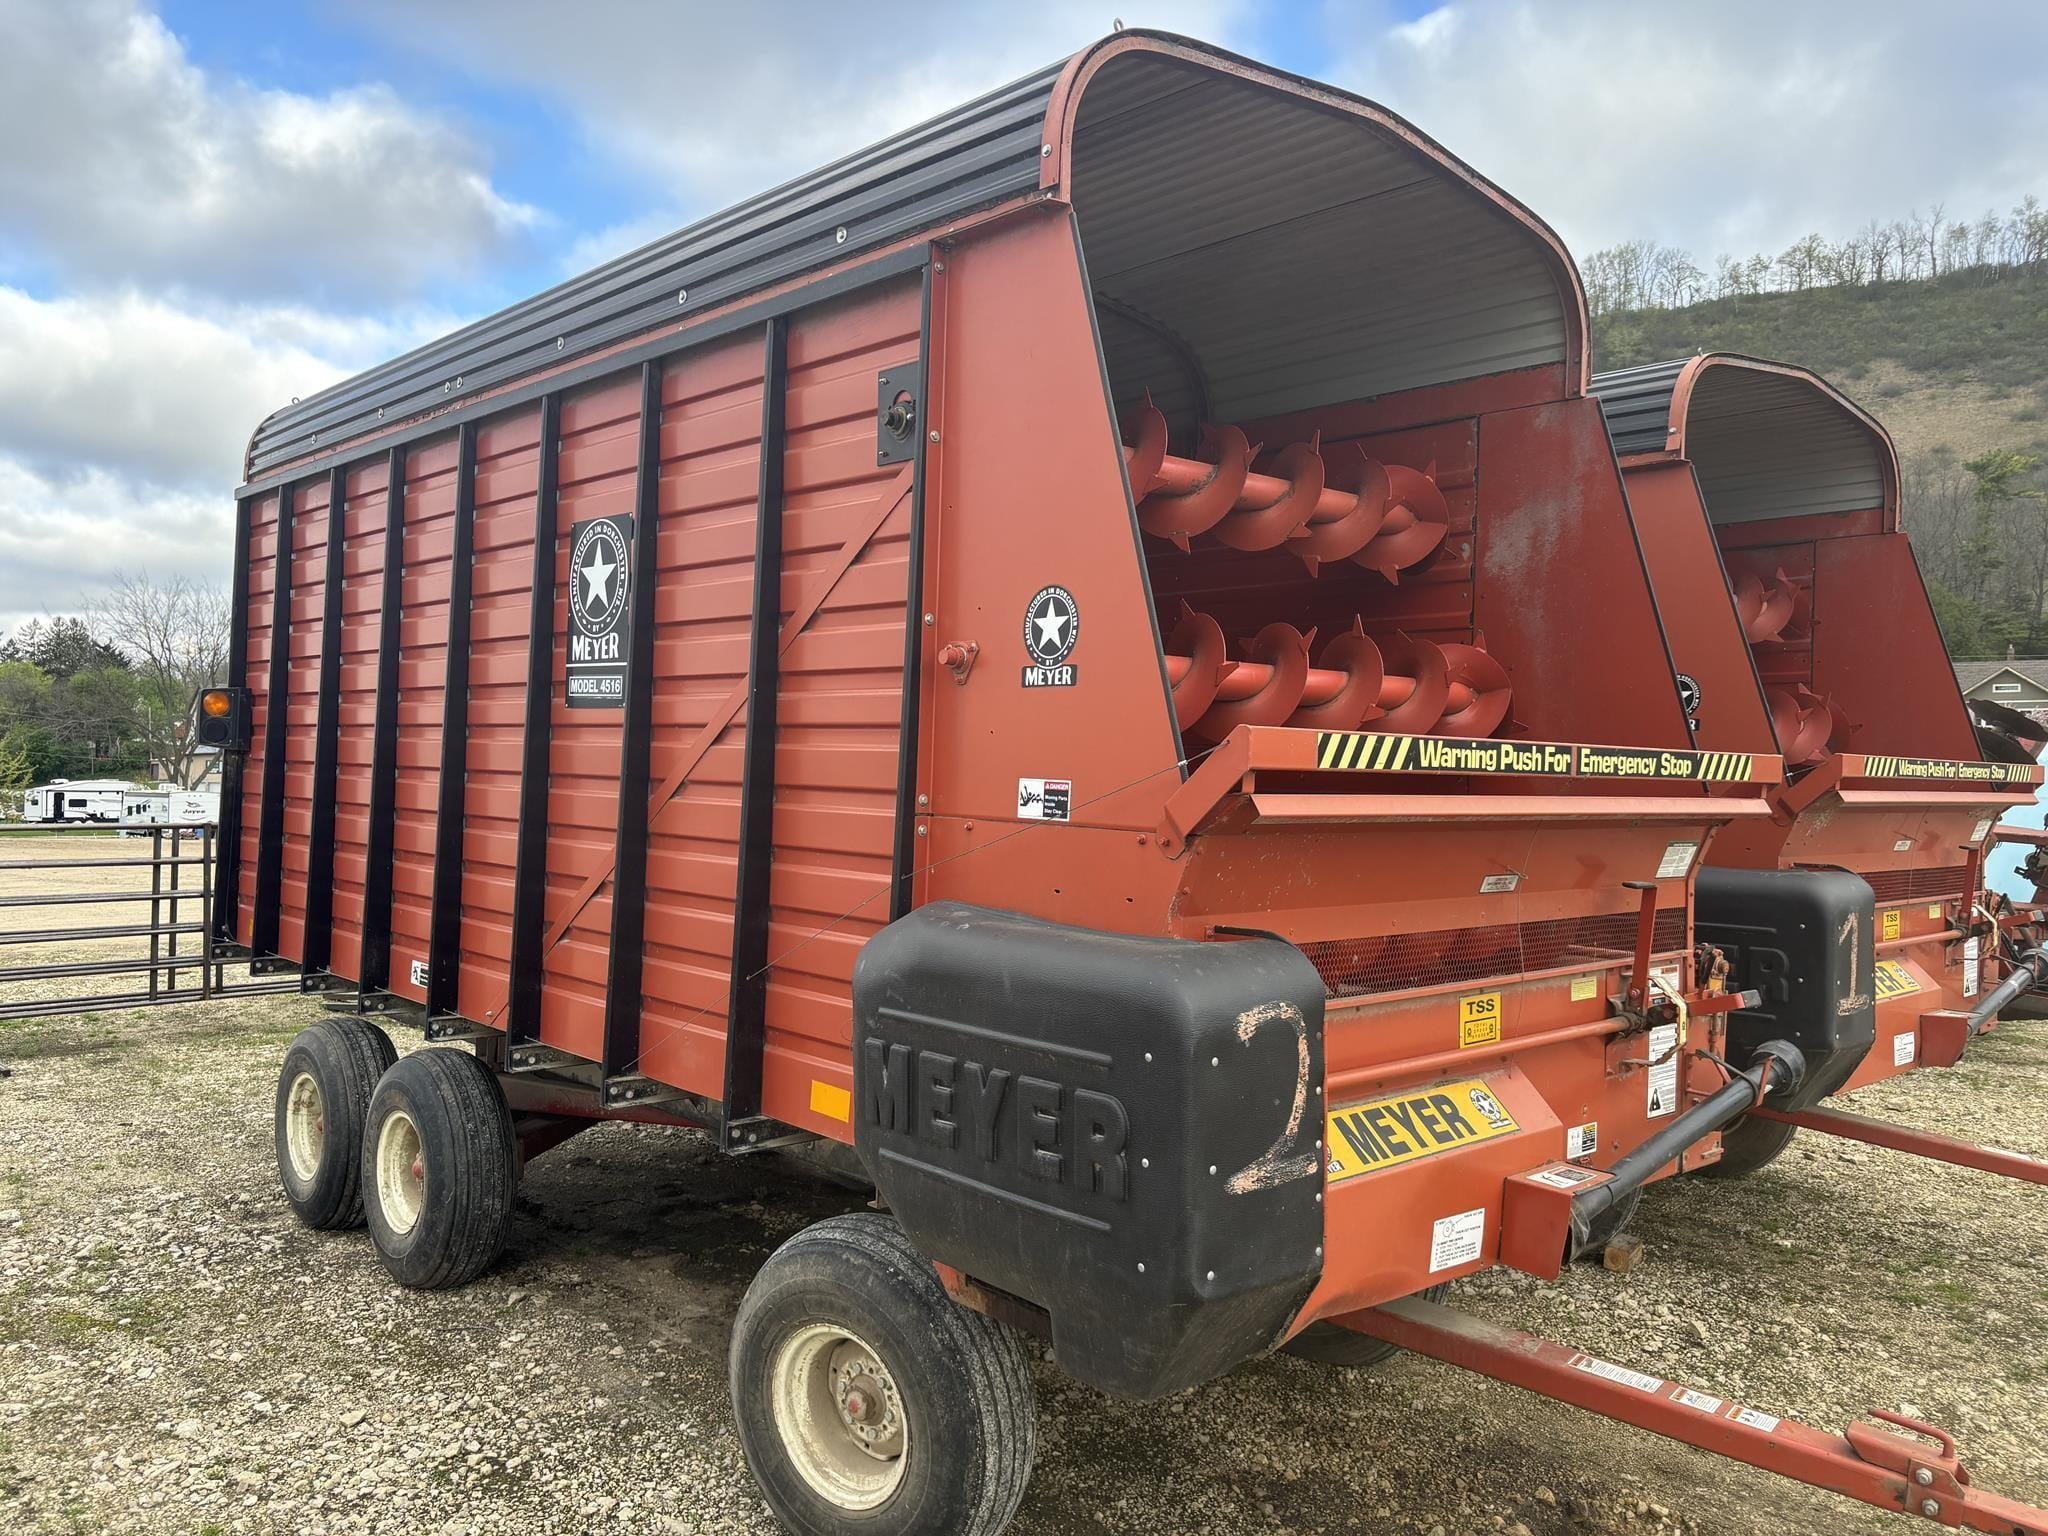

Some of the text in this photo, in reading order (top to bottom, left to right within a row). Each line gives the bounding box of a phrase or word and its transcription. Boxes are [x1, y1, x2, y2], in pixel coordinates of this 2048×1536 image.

[572, 529, 594, 611] MANUFACTURED
[594, 525, 602, 533] IN
[603, 525, 626, 581] DORCHESTER
[593, 623, 600, 632] BY
[571, 633, 619, 661] MEYER
[570, 676, 621, 693] MODEL 4516
[1025, 667, 1072, 686] MEYER
[1418, 739, 1692, 777] Warning Push For Emergency Stop
[1898, 759, 2006, 779] Warning Push For Emergency Stop
[1886, 913, 1898, 923] TSS
[1837, 911, 1870, 1017] 1
[1466, 998, 1495, 1016] TSS
[1223, 1000, 1319, 1197] 2
[864, 1036, 1129, 1202] MEYER
[1332, 1093, 1478, 1165] MEYER
